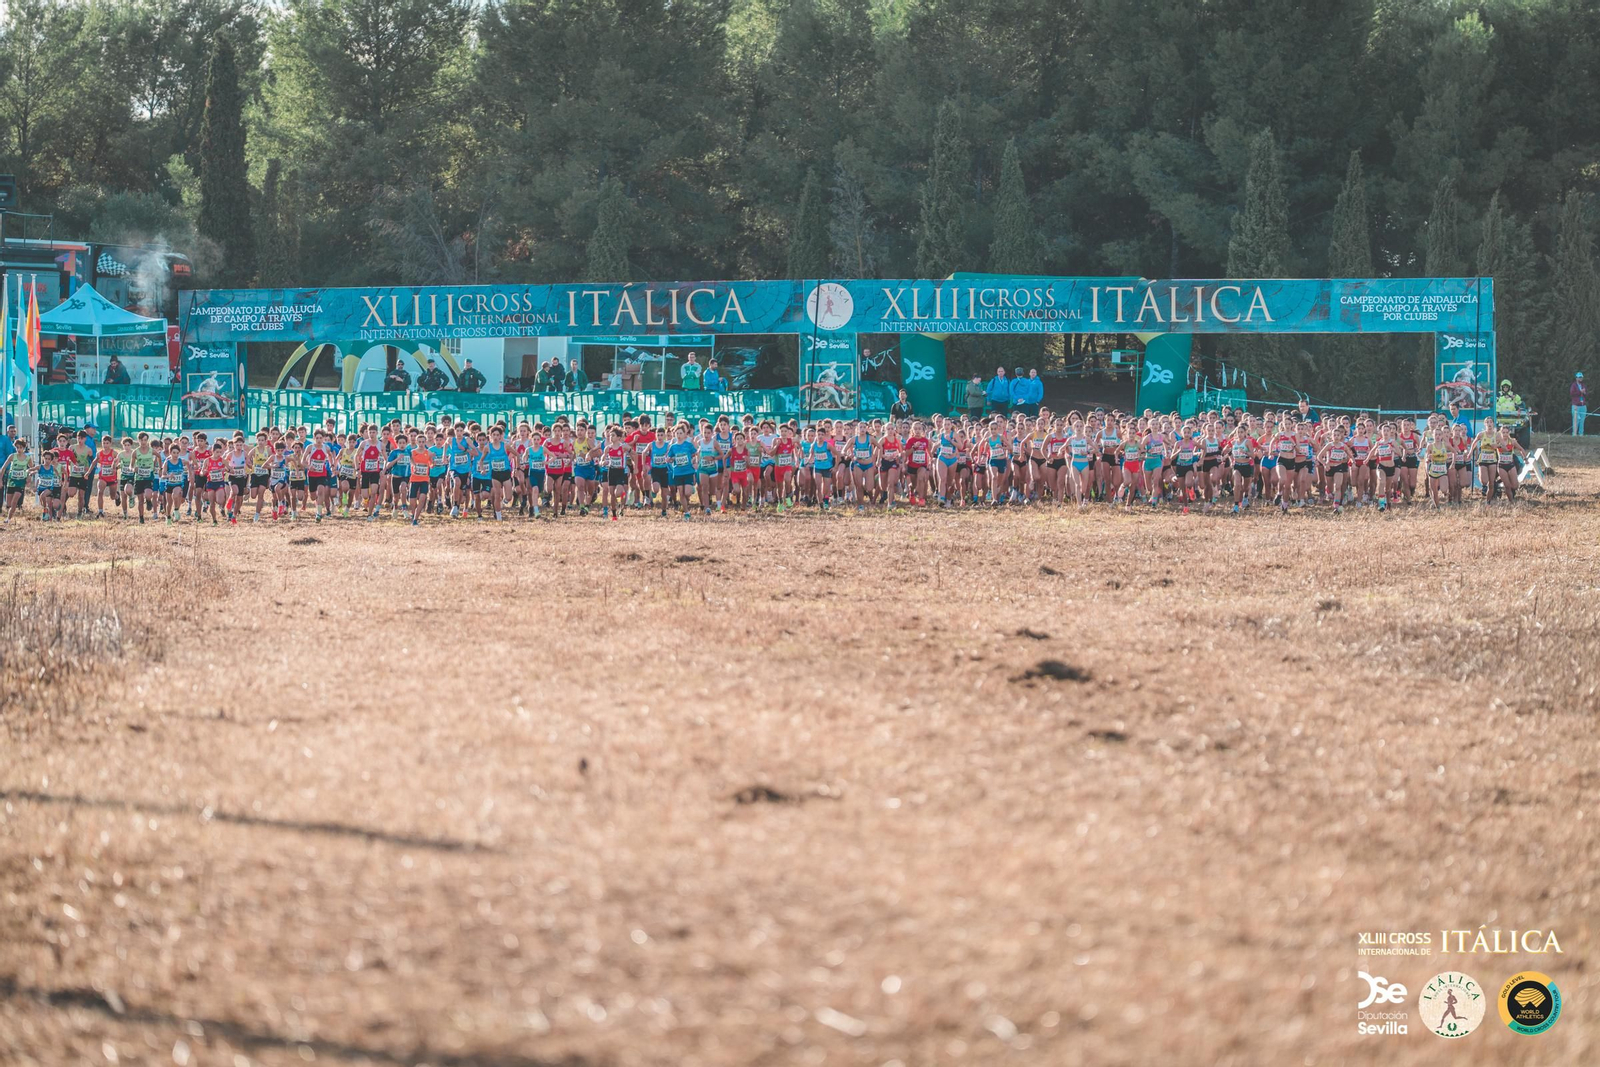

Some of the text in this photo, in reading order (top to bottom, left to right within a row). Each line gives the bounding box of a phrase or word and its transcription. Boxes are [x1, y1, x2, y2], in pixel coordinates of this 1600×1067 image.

[567, 283, 750, 326] ITÁLICA
[881, 288, 1055, 320] XLIII CROSS
[1090, 280, 1275, 322] ITÁLICA
[1340, 294, 1478, 304] CAMPEONATO DE ANDALUCÍA
[190, 306, 253, 315] CAMPEONATO
[268, 304, 323, 313] ANDALUCÍA
[360, 292, 532, 327] XLIII CROSS
[980, 309, 1083, 320] INTERNACIONAL
[210, 315, 222, 323] DE
[223, 314, 257, 323] CAMPO
[458, 313, 560, 325] INTERNACIONAL
[231, 322, 284, 331] POR CLUBES
[880, 321, 1064, 332] INTERNATIONAL CROSS COUNTRY
[360, 326, 542, 339] INTERNATIONAL CROSS COUNTRY
